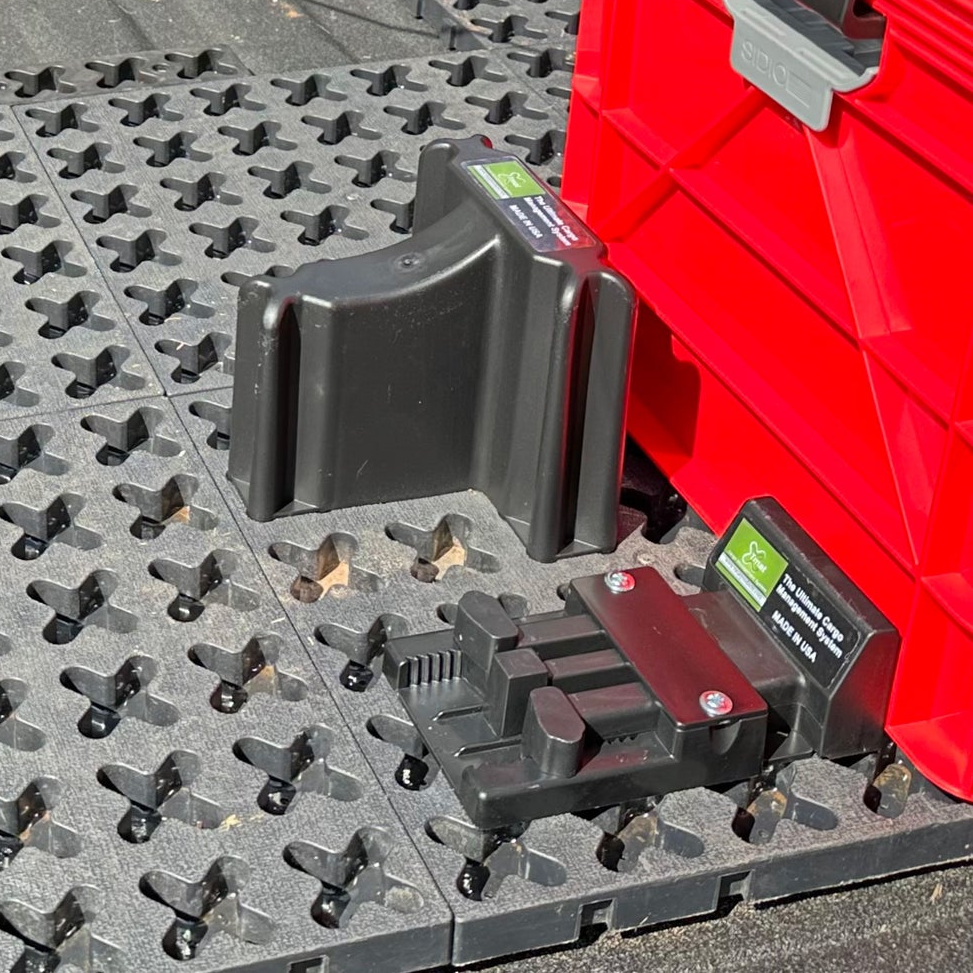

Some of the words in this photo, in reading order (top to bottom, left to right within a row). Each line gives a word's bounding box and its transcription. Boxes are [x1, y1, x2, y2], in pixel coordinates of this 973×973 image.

[771, 610, 795, 638] MADE
[791, 631, 803, 646] IN
[800, 640, 817, 663] USA
[776, 583, 819, 633] Management
[815, 627, 843, 659] System
[782, 573, 797, 592] The
[795, 586, 823, 621] Ultimate
[822, 615, 844, 643] Cargo
